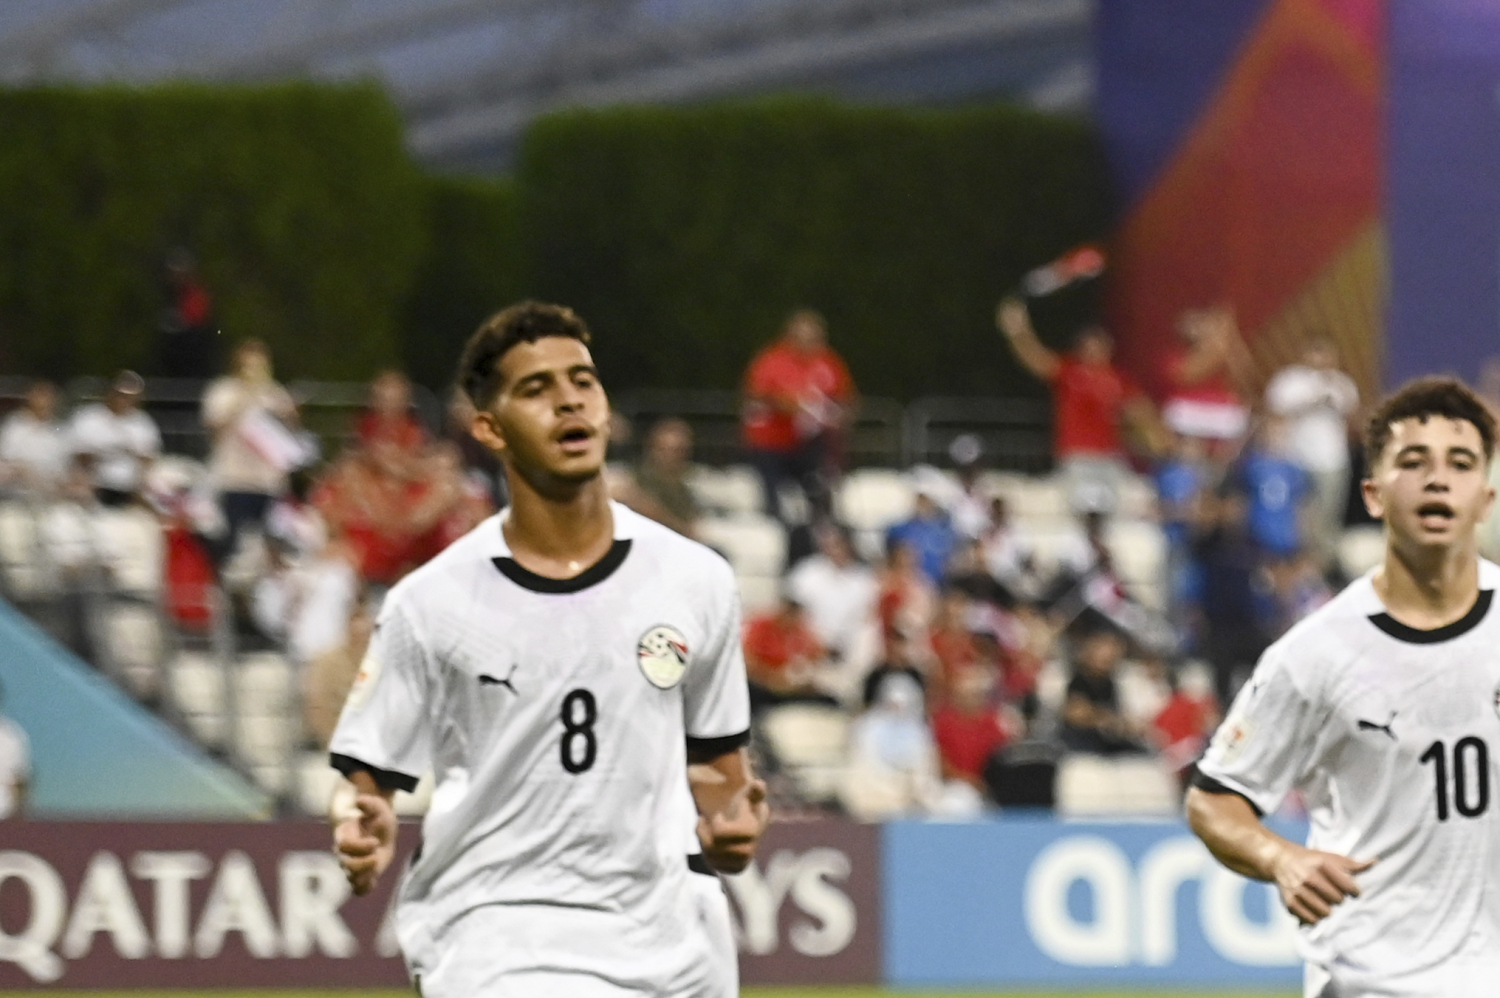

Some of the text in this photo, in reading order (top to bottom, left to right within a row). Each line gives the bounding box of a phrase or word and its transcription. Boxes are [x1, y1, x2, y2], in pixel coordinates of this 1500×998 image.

[561, 688, 597, 775] 8
[1419, 736, 1489, 821] 10
[0, 850, 357, 982] QATAR
